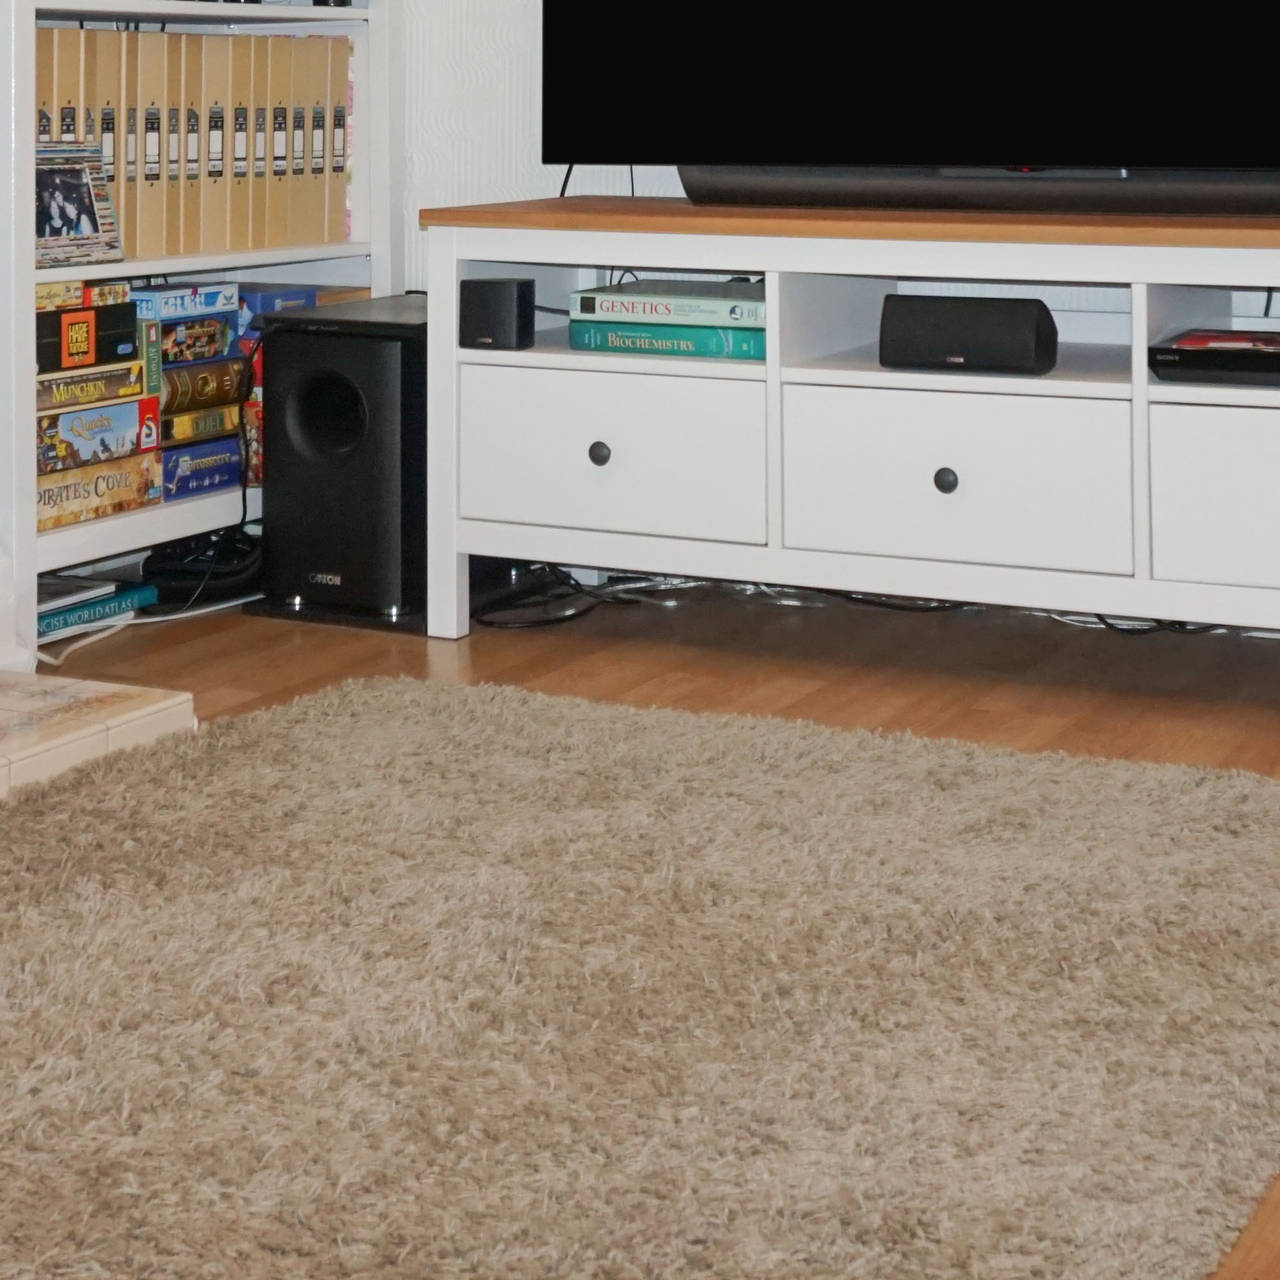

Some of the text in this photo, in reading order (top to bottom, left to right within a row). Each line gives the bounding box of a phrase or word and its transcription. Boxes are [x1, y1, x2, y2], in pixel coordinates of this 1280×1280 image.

[599, 299, 672, 316] GENETICS
[607, 333, 695, 351] BIOCHEMISTRY
[1156, 354, 1180, 362] SONY
[52, 380, 106, 403] MUNCHKIN
[94, 472, 131, 498] COVE
[67, 607, 103, 624] WORLD
[103, 598, 132, 614] ATLAS
